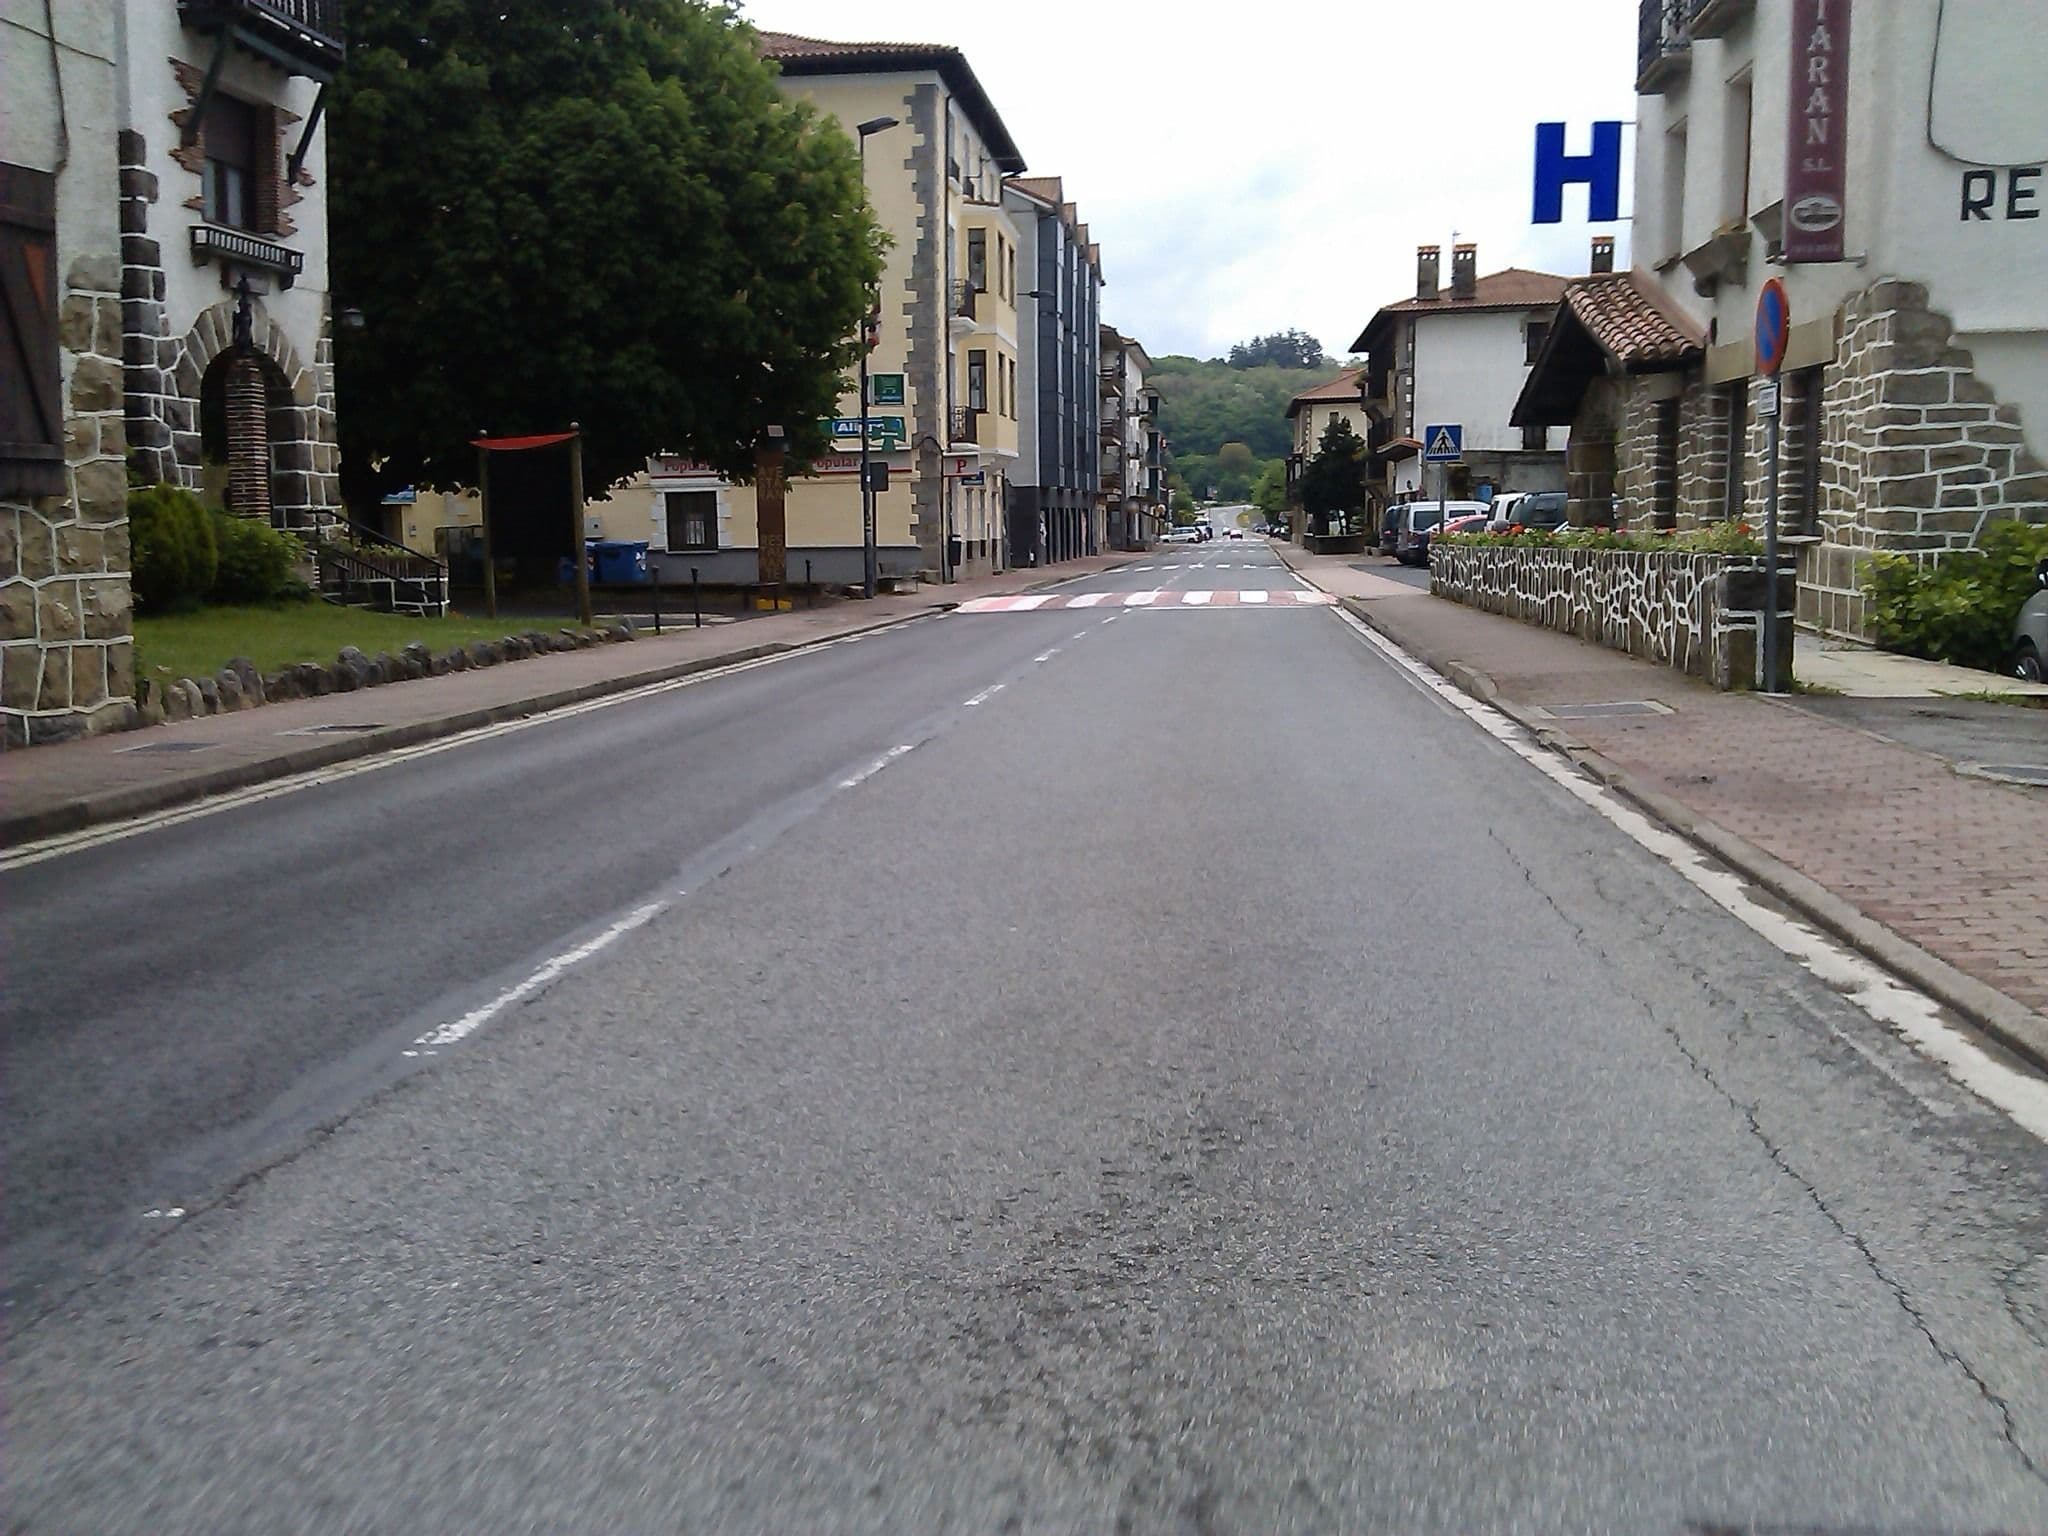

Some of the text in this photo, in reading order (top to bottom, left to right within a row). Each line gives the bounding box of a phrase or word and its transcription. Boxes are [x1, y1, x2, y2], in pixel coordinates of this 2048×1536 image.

[1531, 120, 1622, 224] H
[1960, 167, 2042, 221] RE
[810, 456, 858, 470] opular
